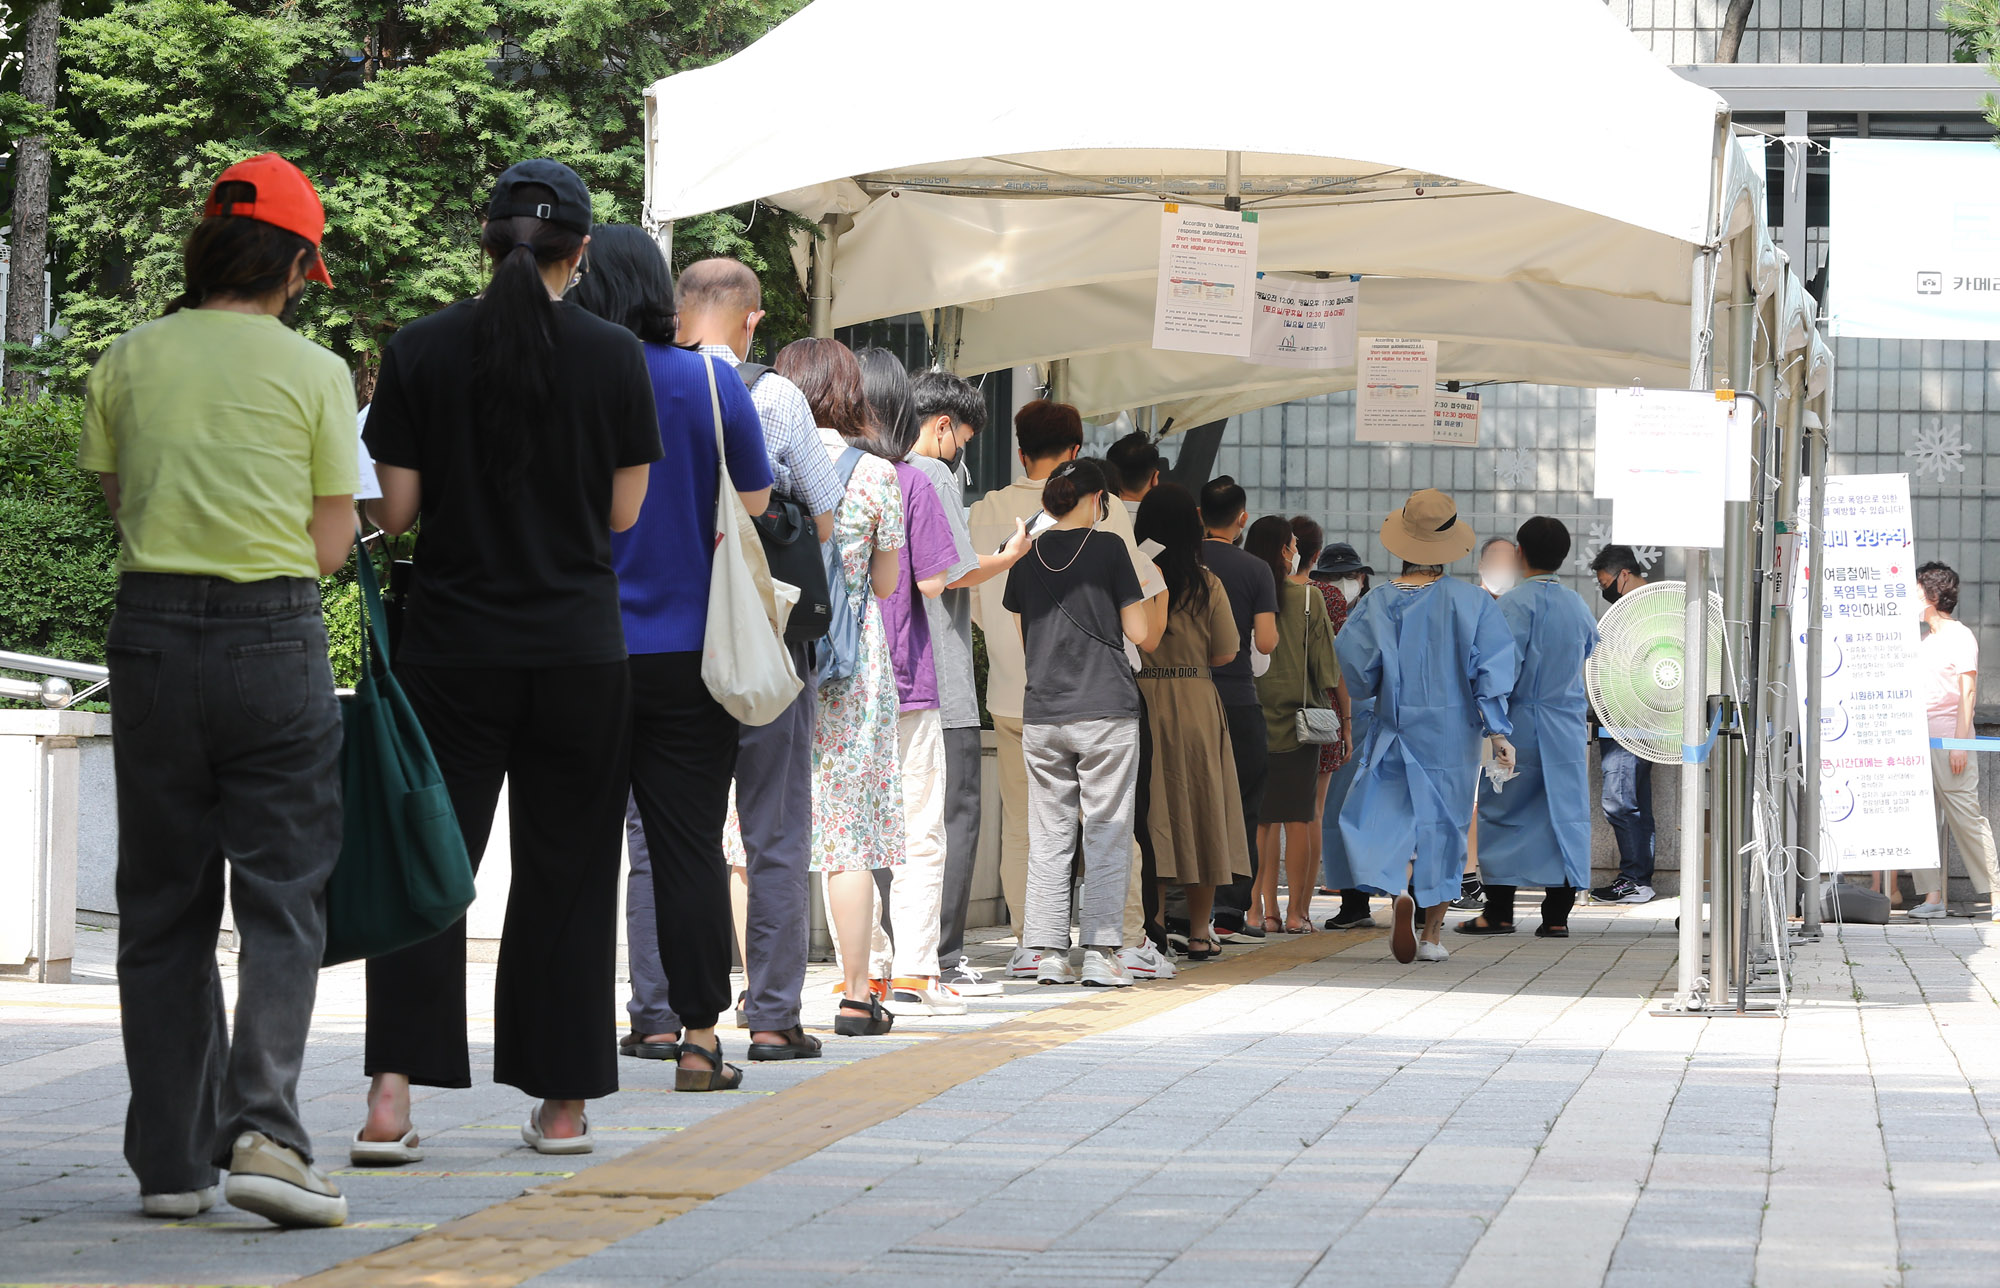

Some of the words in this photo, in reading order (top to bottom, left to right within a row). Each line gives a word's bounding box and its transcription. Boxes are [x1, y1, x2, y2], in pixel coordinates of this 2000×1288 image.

[1183, 220, 1206, 228] According
[1882, 494, 1898, 503] 인한
[1833, 507, 1856, 516] 예방할
[1860, 506, 1867, 515] 수
[1824, 567, 1881, 581] 여름철에는
[1833, 584, 1878, 599] 폭염특보
[1884, 583, 1906, 598] 등을
[1822, 604, 1833, 619] 일
[1839, 602, 1901, 617] 확인하세요.
[1857, 632, 1873, 642] 자주
[1876, 631, 1902, 642] 마시기
[1179, 667, 1198, 678] DIOR
[1850, 690, 1884, 701] 시원하게
[1887, 689, 1913, 699] 지내기
[1836, 758, 1883, 769] 시간대에는
[1887, 755, 1925, 766] 휴식하기
[1861, 848, 1911, 857] 서초구보건소
